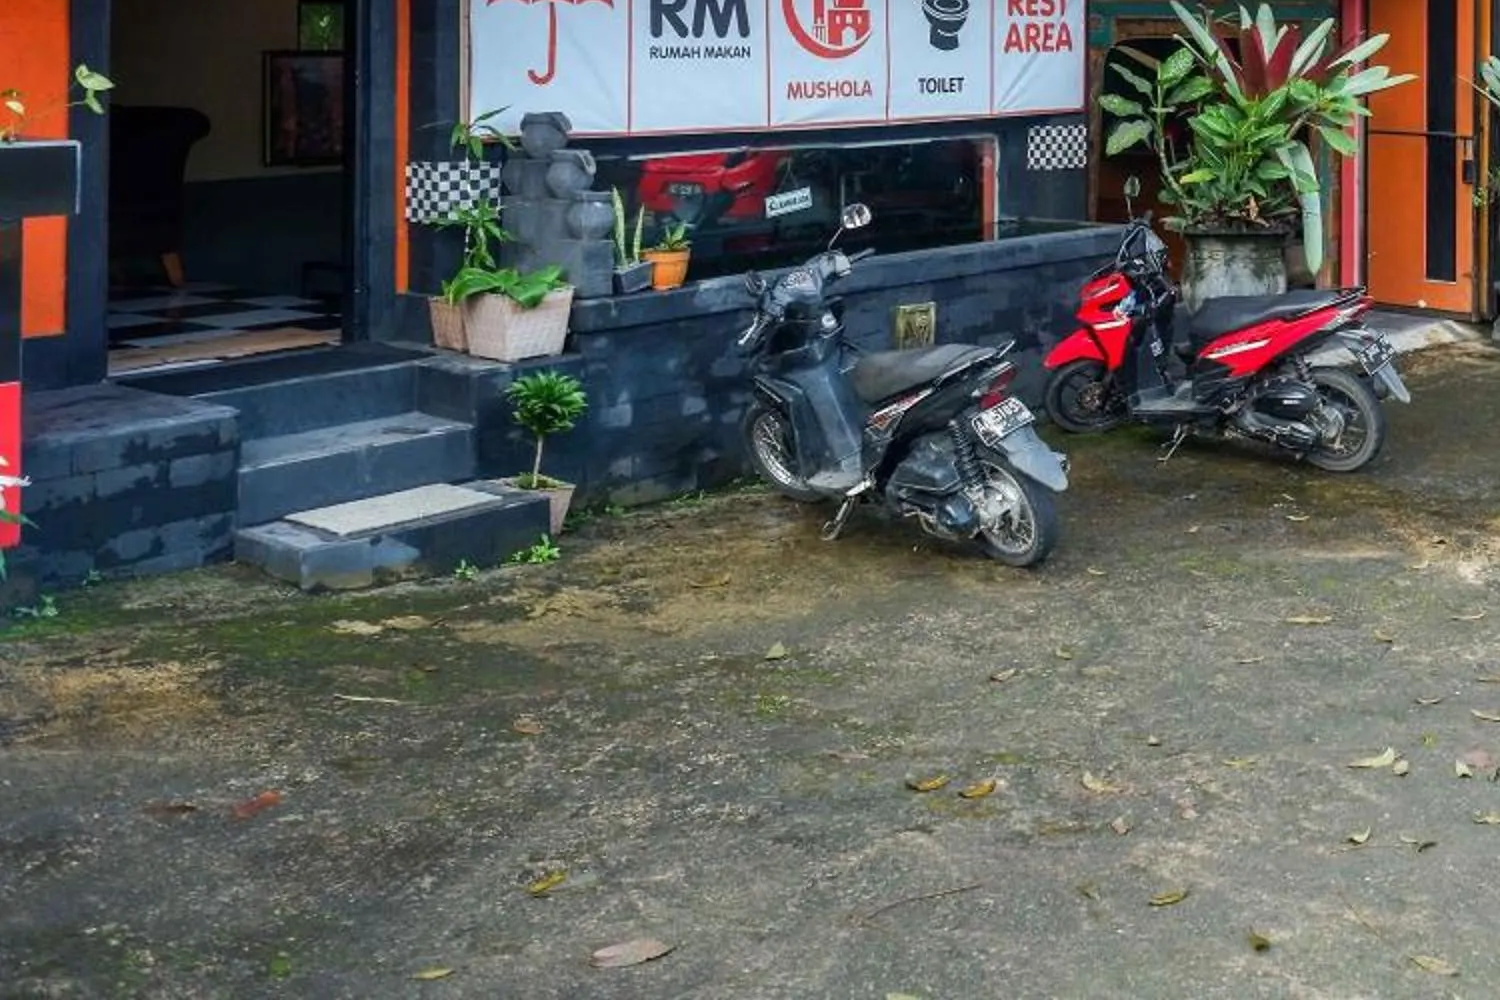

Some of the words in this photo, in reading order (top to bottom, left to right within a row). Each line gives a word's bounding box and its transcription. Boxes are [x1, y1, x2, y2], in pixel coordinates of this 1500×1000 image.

[1004, 22, 1073, 53] AREA
[649, 45, 700, 59] RUMAH
[703, 46, 751, 59] MAKAN
[787, 80, 873, 100] MUSHOLA
[918, 77, 965, 95] TOILET
